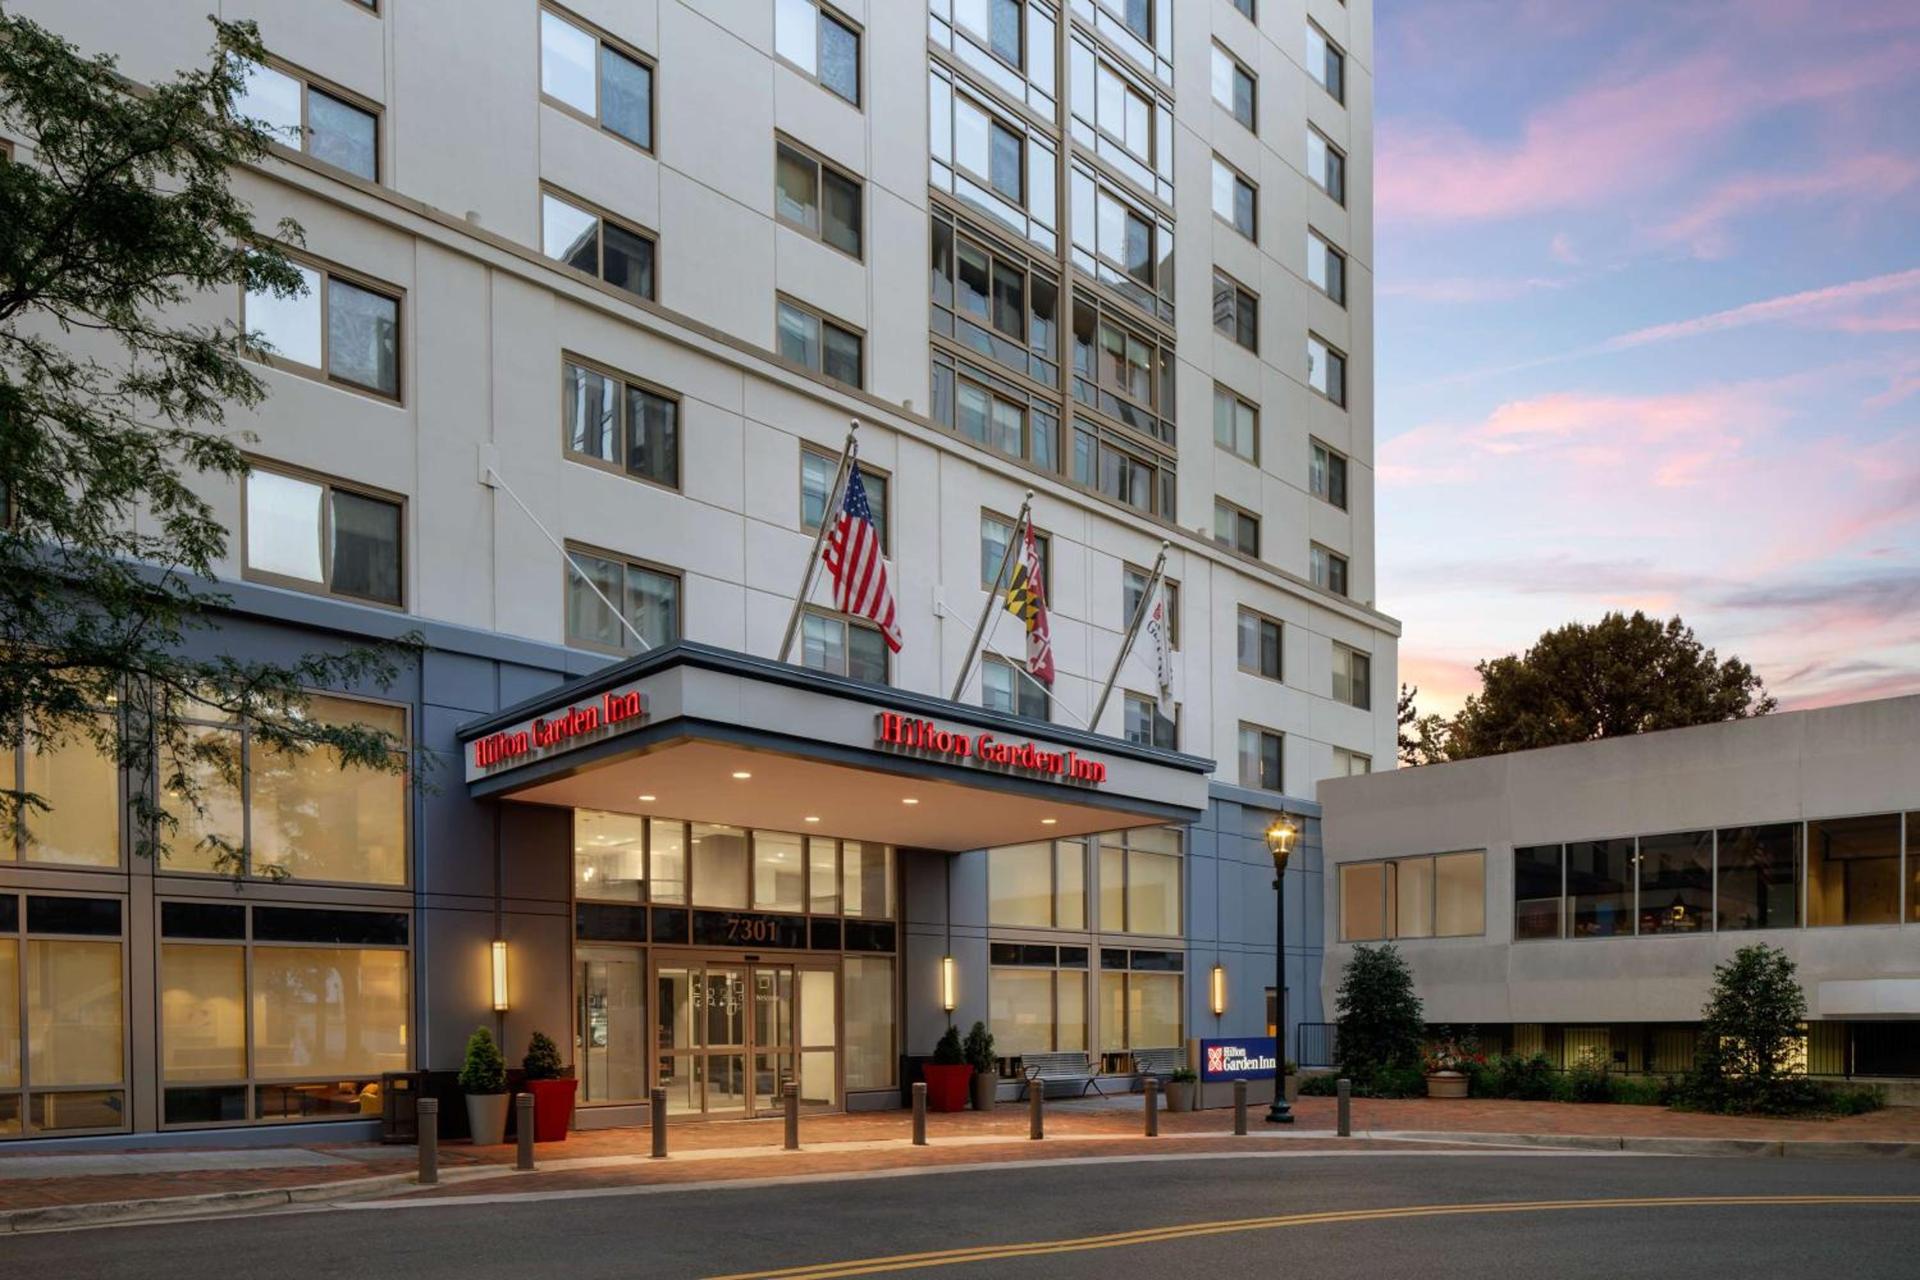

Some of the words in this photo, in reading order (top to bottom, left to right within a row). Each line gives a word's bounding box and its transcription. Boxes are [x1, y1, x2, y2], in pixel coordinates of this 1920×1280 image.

[474, 731, 529, 768] Hilton
[531, 705, 599, 748] Garden
[602, 690, 642, 727] Inn
[880, 711, 972, 757] Hilton
[977, 732, 1064, 775] Garden
[1068, 750, 1106, 783] Inn
[727, 918, 777, 941] 7301
[1223, 1046, 1246, 1057] Hilton
[1223, 1056, 1259, 1071] Garden
[1259, 1055, 1277, 1069] Inn
